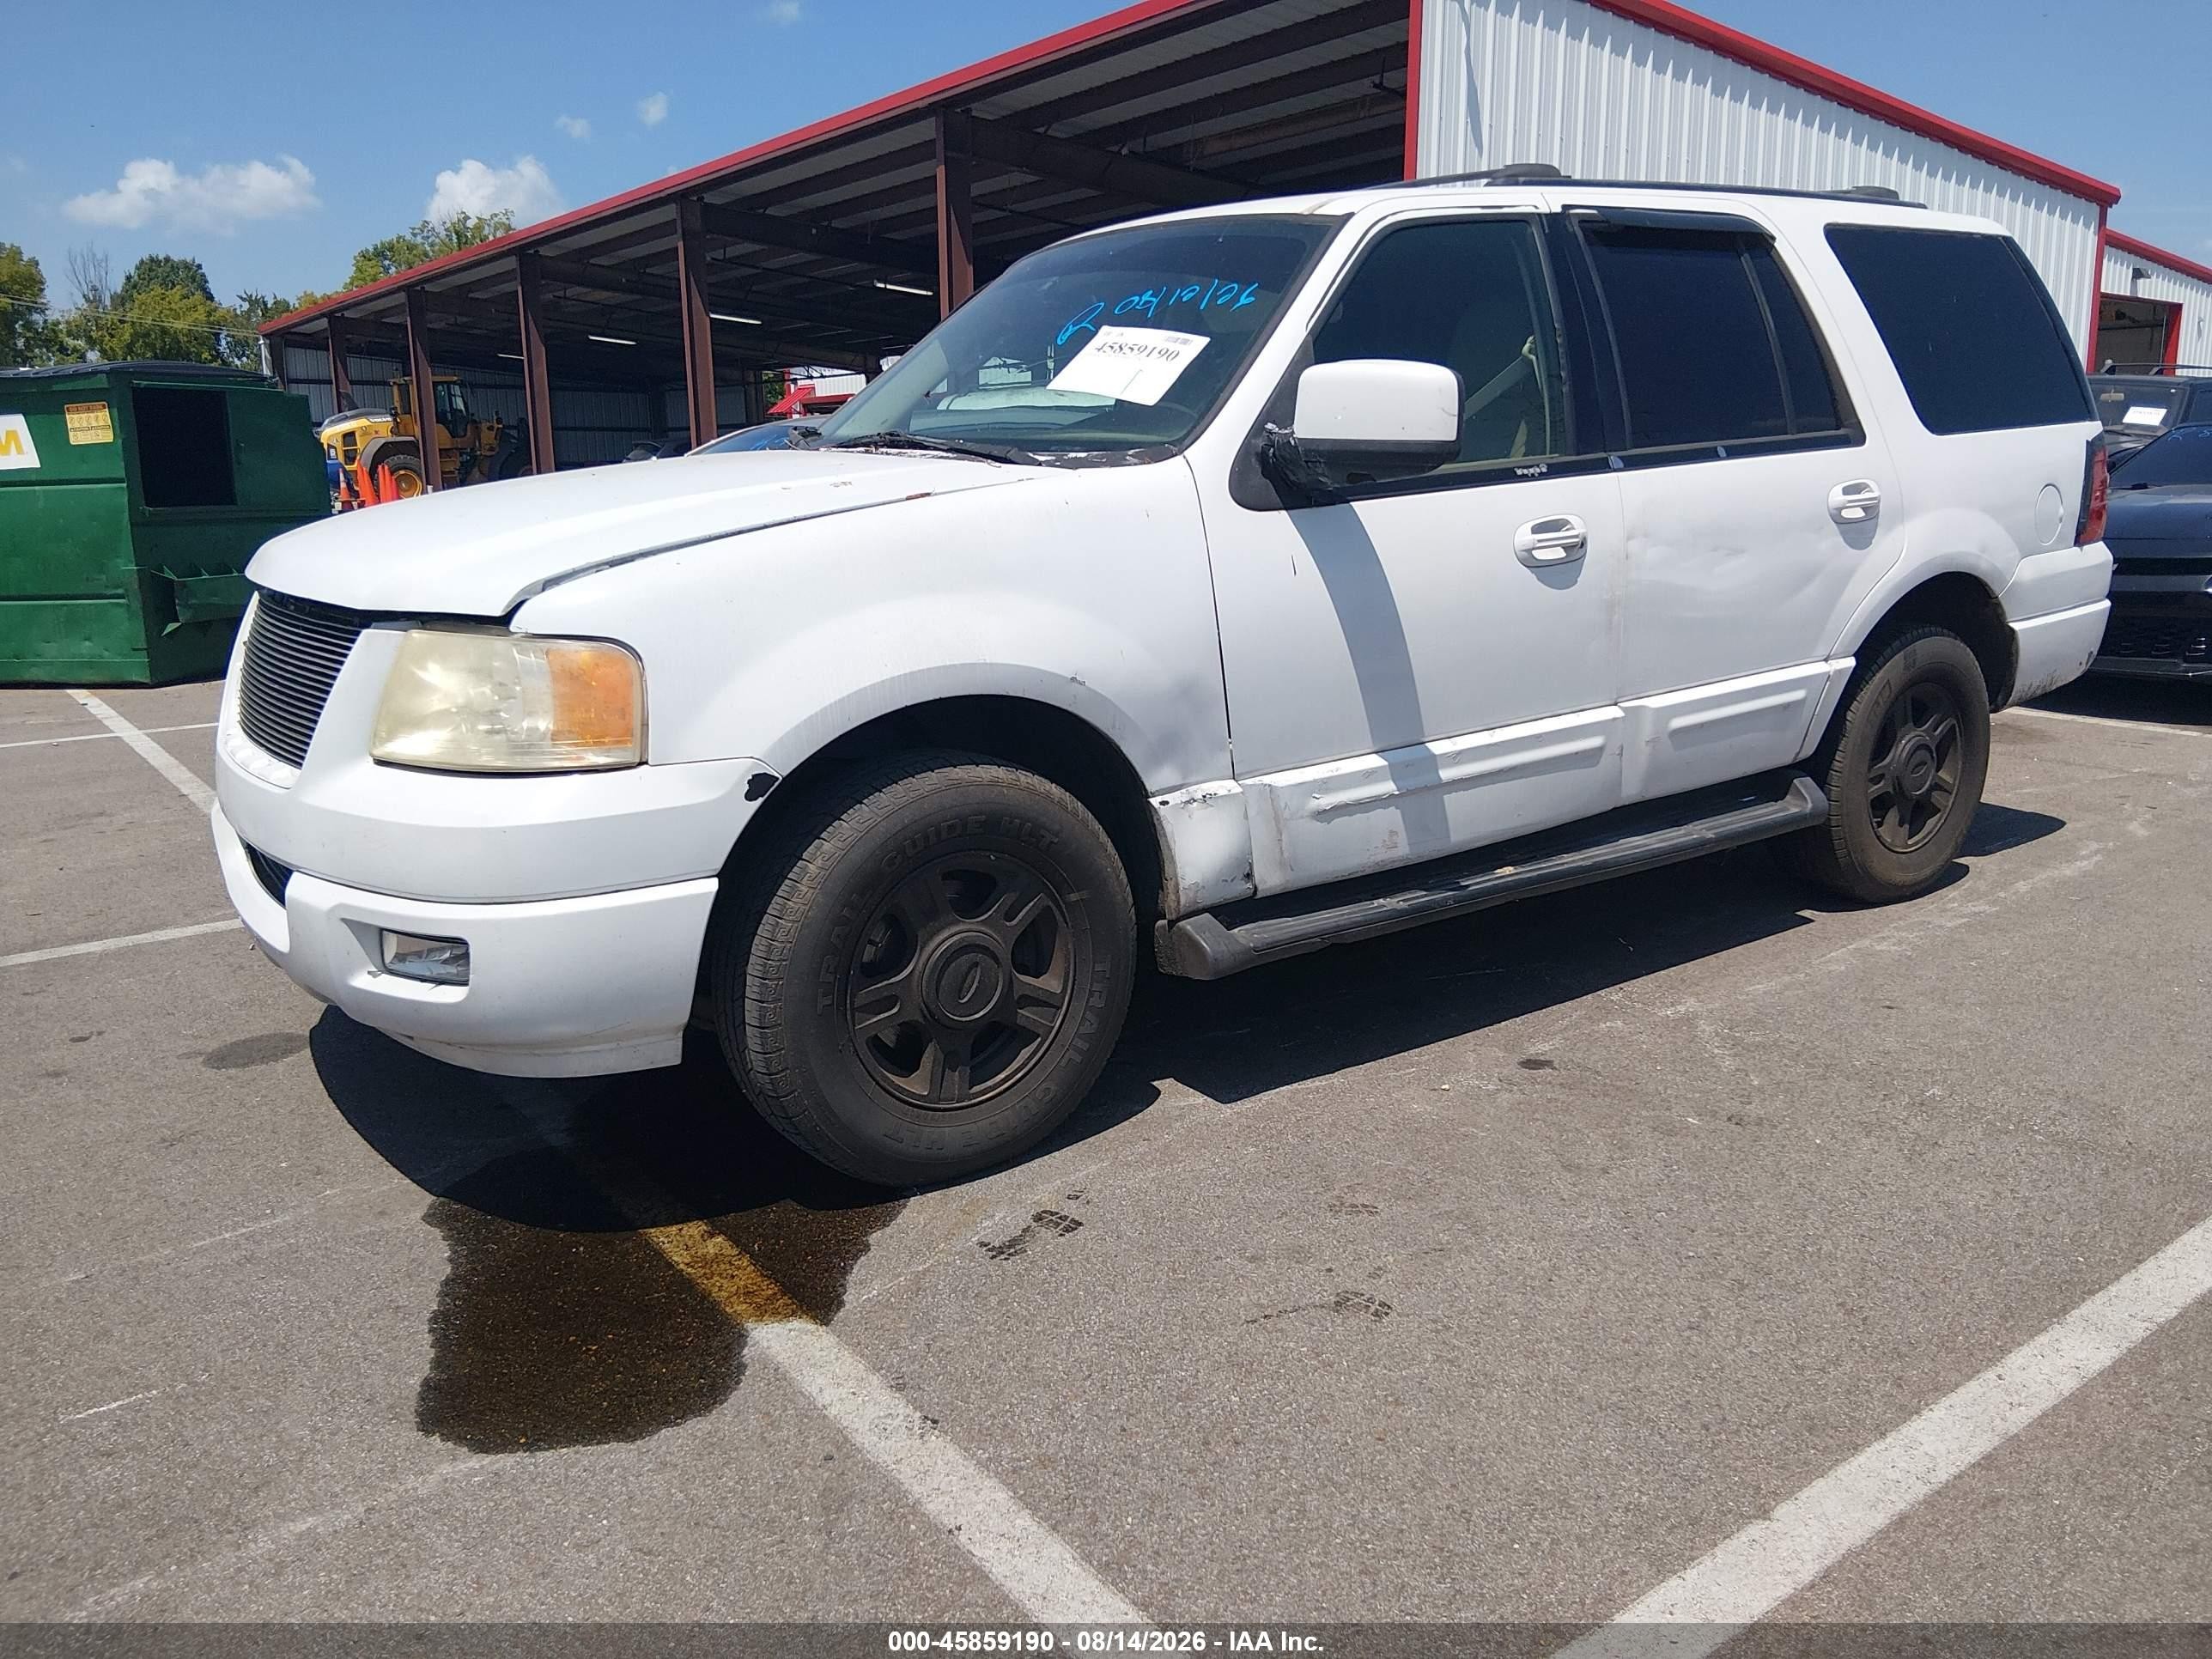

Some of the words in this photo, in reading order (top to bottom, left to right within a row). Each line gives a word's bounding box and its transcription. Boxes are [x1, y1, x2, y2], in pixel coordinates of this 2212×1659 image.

[1095, 341, 1181, 362] 45859190
[881, 814, 988, 872] GUIDE
[1058, 953, 1112, 1071] TRAIL
